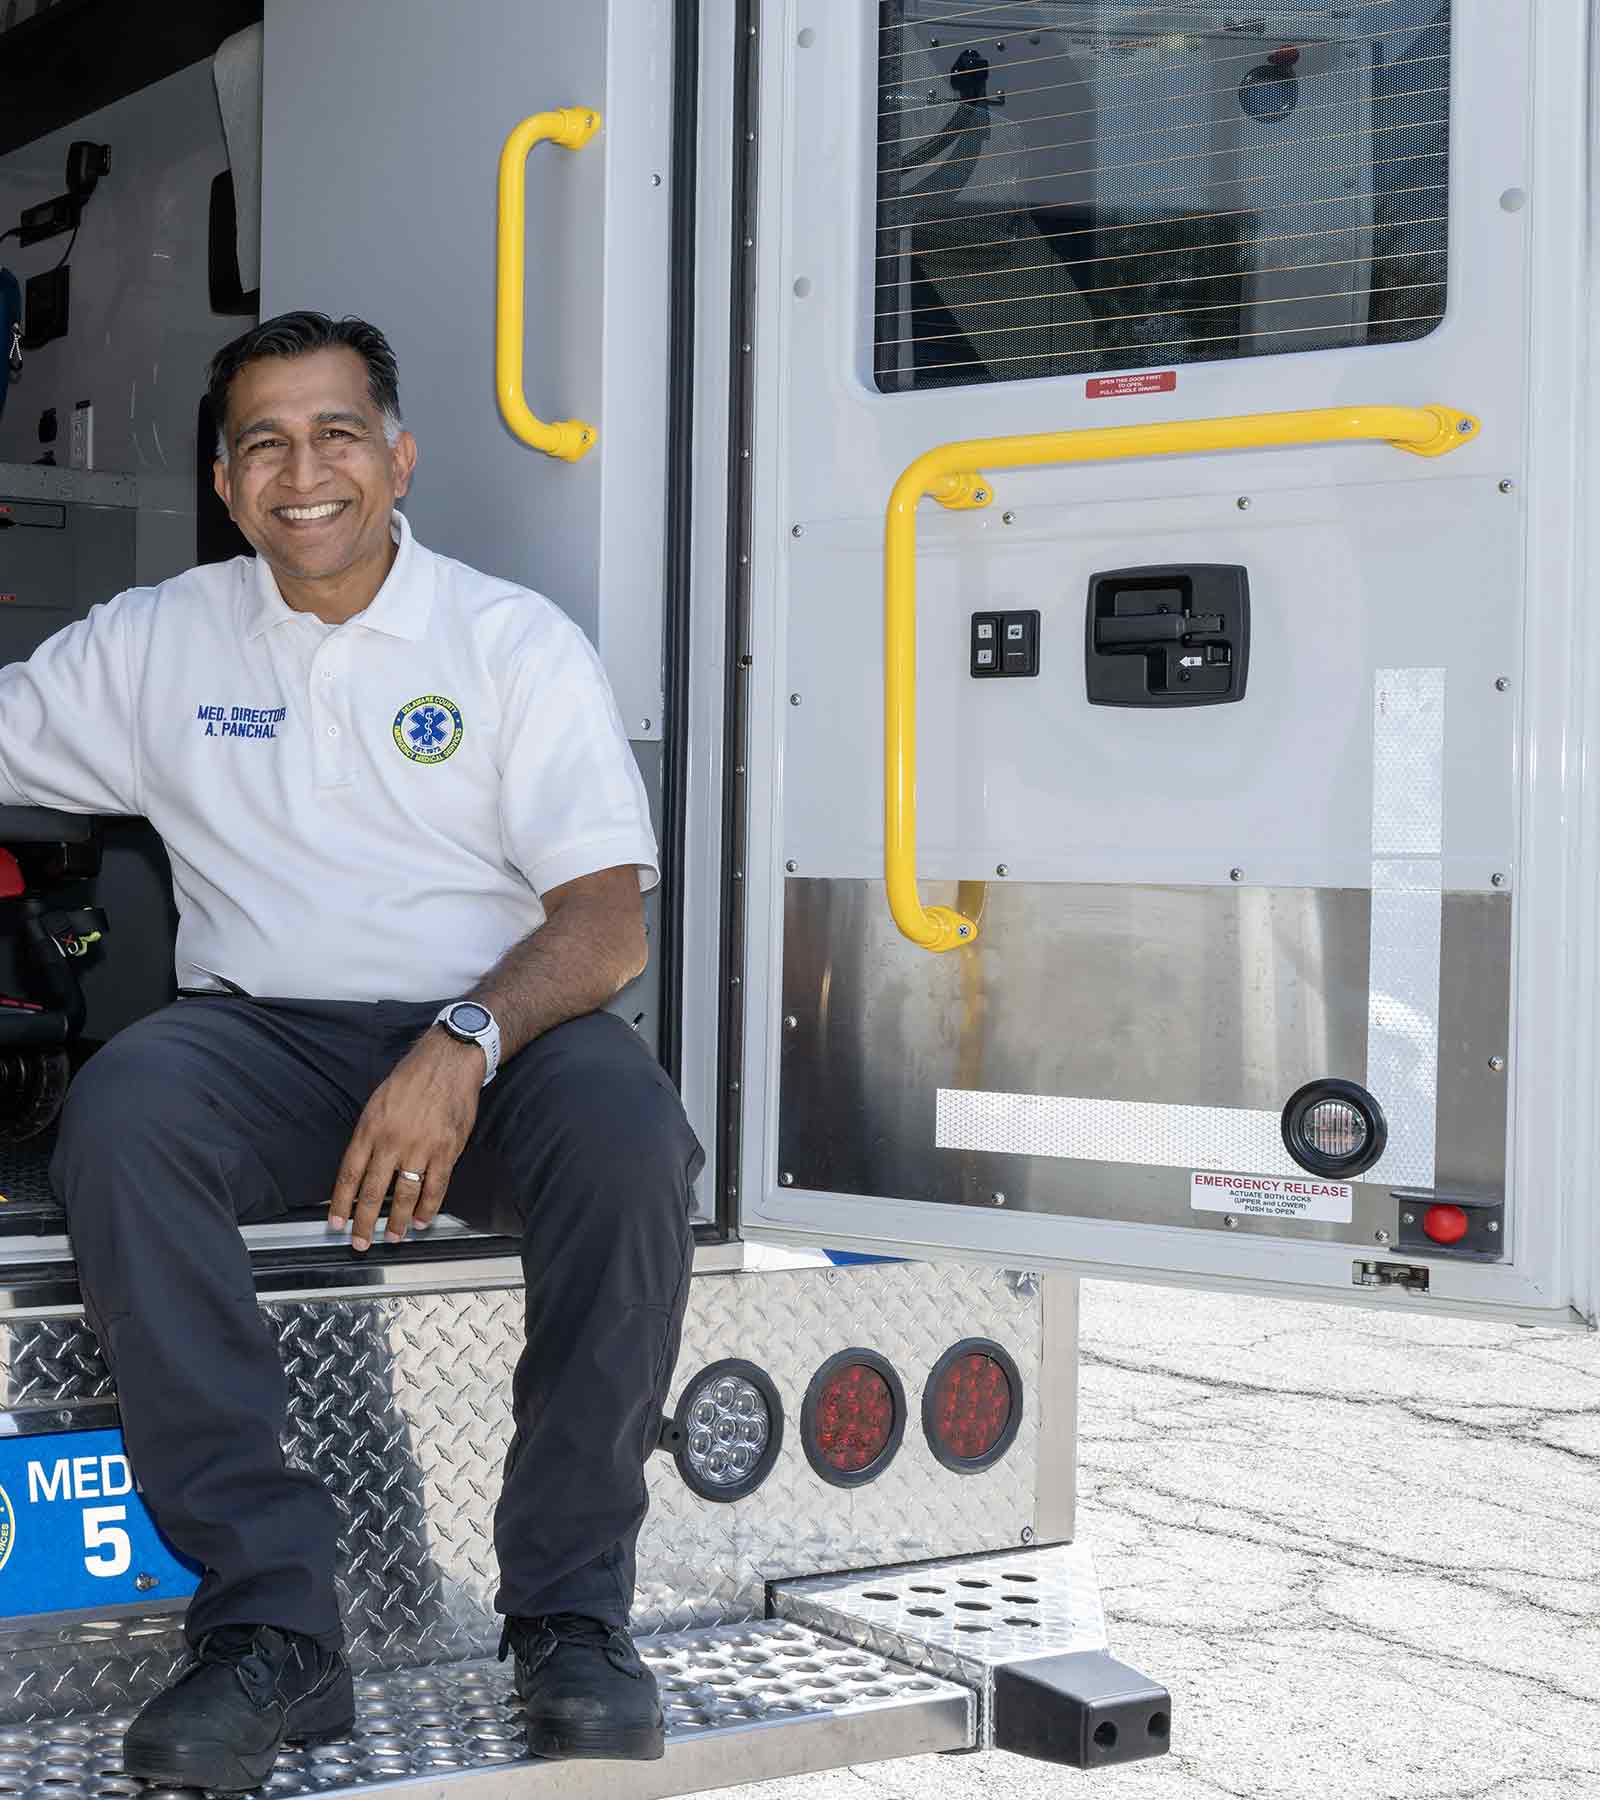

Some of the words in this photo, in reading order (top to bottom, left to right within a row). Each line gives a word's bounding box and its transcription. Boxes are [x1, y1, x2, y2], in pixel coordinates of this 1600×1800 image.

[197, 705, 227, 721] MED.
[230, 706, 286, 723] DIRECTOR
[402, 696, 433, 714] DELAWARE
[434, 696, 458, 713] COUNTY
[205, 722, 218, 737] A.
[221, 722, 277, 739] PANCHAL
[394, 727, 416, 759] EMERGENCY
[443, 728, 462, 757] SERVICES
[1195, 1175, 1280, 1192] EMERGENCY
[1283, 1182, 1349, 1198] RELEASE
[1229, 1190, 1263, 1199] ACTUATE
[1264, 1193, 1285, 1201] BOTH
[1286, 1195, 1312, 1203] LOCKS
[1234, 1197, 1262, 1206] (UPPER
[1277, 1201, 1307, 1210] LOWER)
[1244, 1205, 1265, 1213] PUSH
[1275, 1207, 1296, 1215] OPEN
[27, 1454, 137, 1503] MED
[82, 1505, 132, 1578] 5
